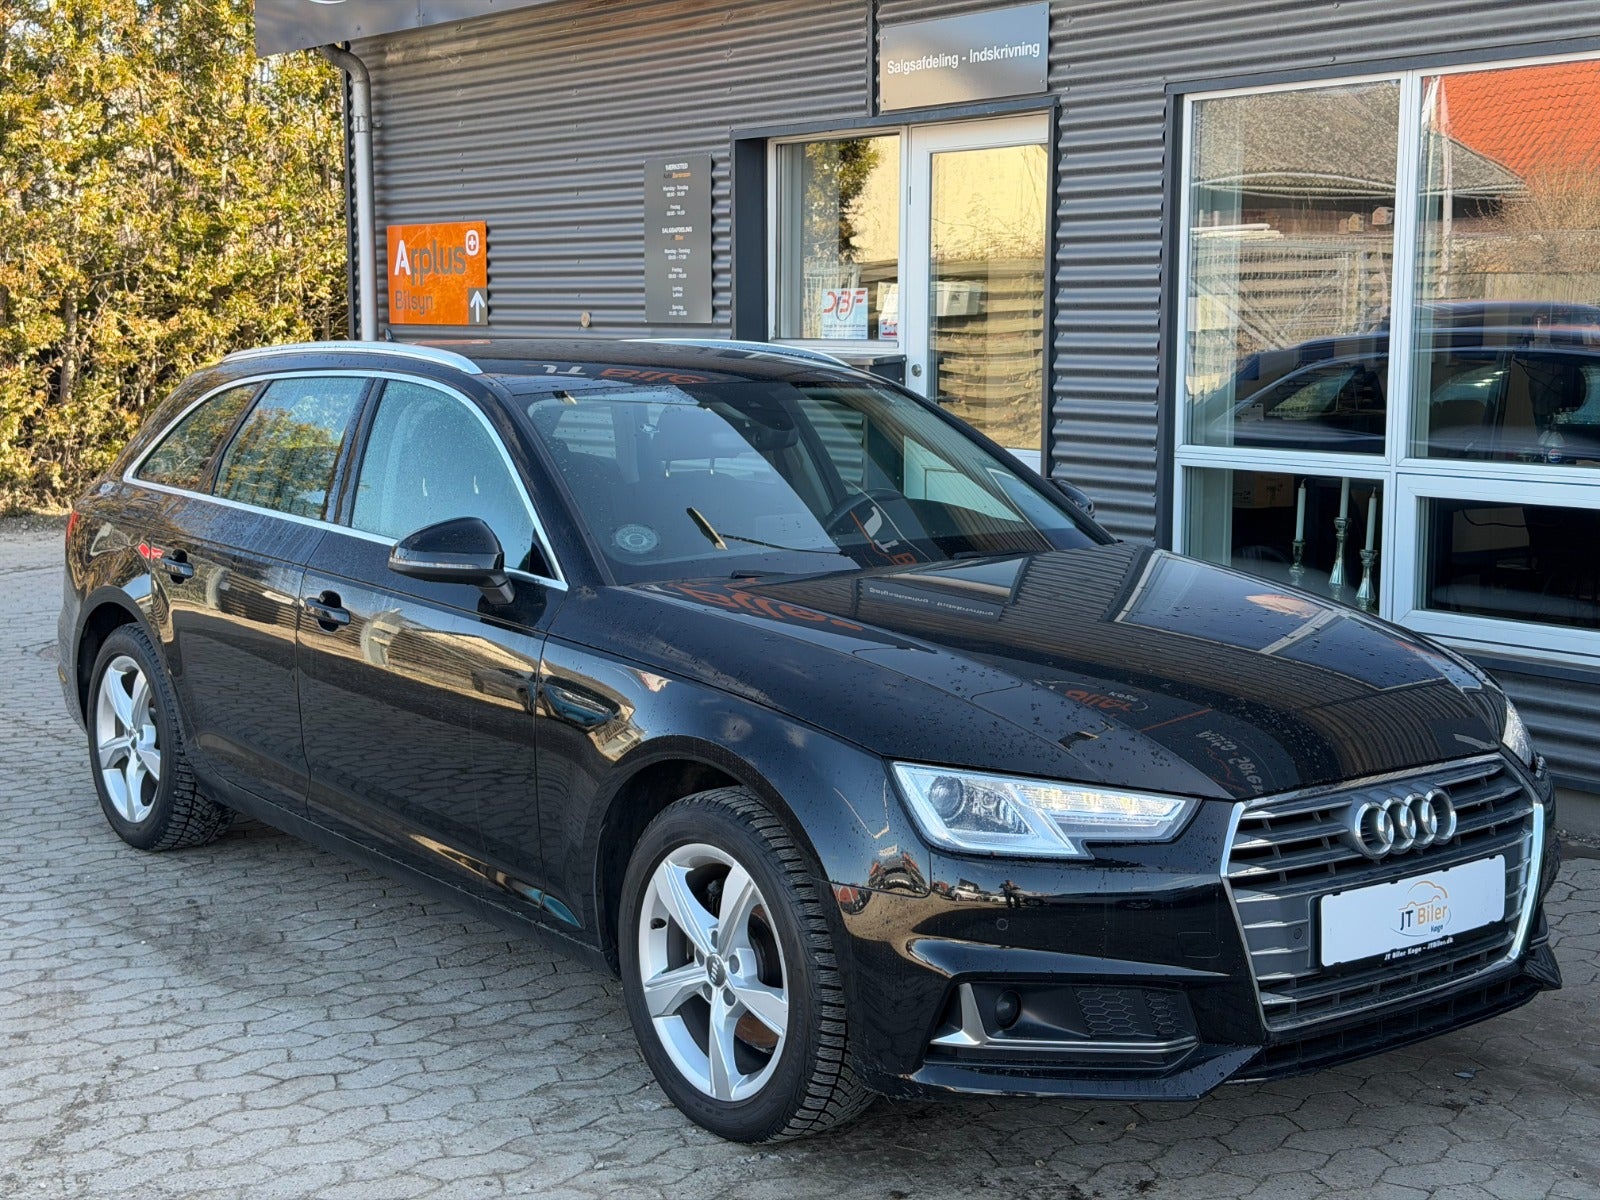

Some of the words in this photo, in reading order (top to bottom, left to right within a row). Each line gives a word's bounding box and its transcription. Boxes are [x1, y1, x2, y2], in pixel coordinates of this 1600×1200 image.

[887, 53, 959, 75] Salgsafdeling
[969, 42, 1041, 63] Indskrivning
[395, 290, 433, 315] Bilsyn
[1400, 910, 1413, 930] JT
[1418, 905, 1447, 924] Biler
